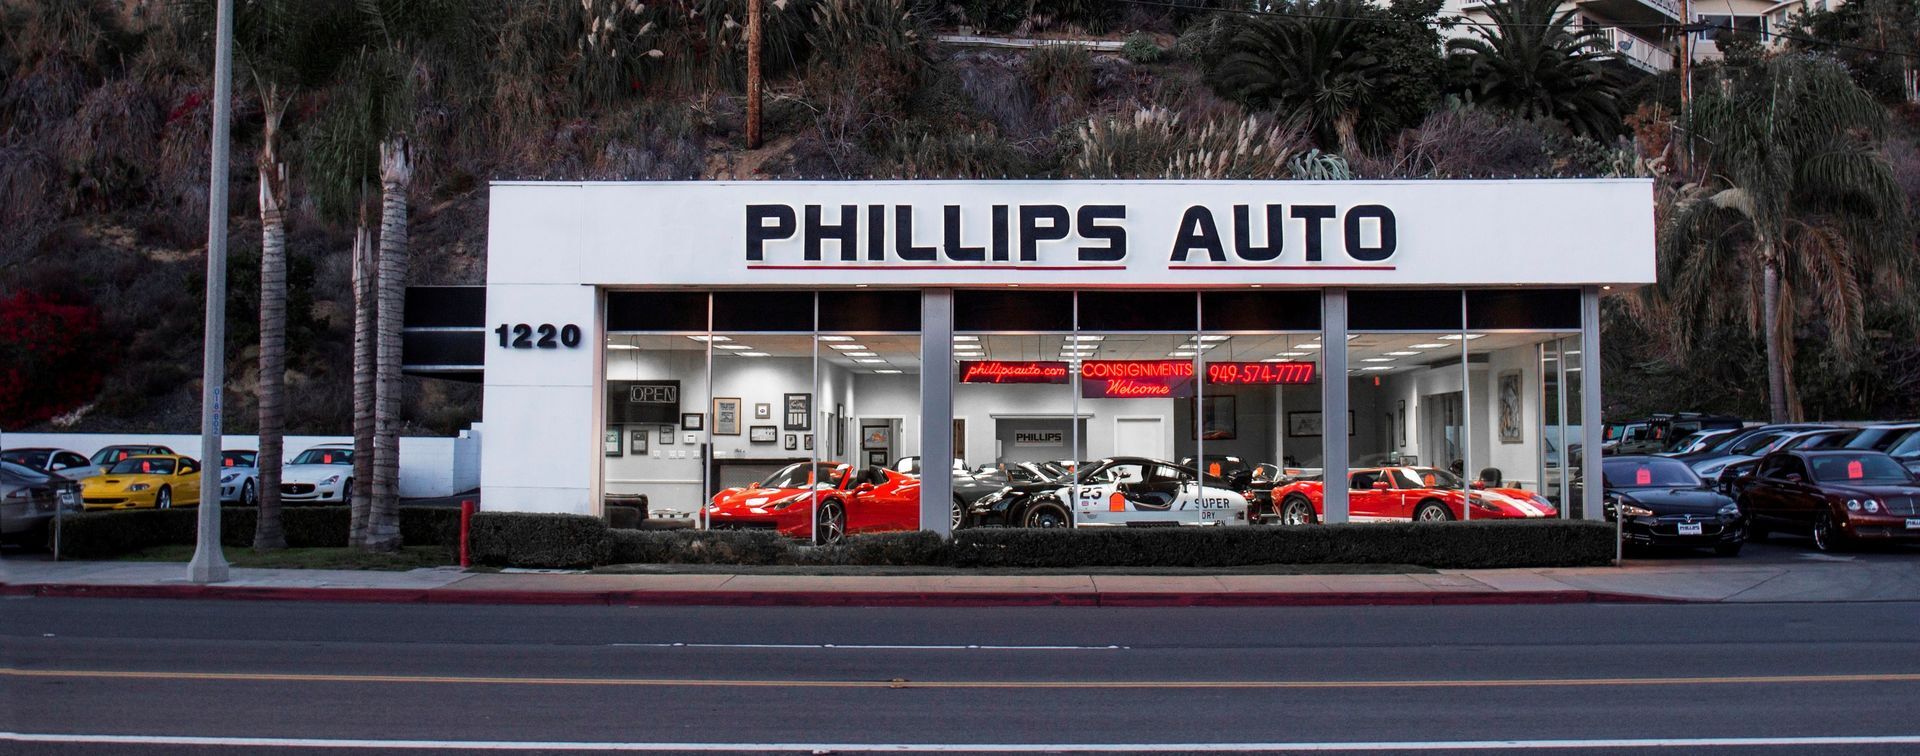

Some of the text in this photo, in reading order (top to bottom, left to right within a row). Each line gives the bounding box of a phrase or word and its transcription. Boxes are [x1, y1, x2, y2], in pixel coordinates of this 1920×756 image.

[746, 204, 1397, 261] PHILLIPS AUTO
[495, 323, 561, 349] 1220
[963, 362, 1066, 383] phillipsauto.com
[1082, 362, 1193, 377] CONSIGNMENTS
[1209, 364, 1313, 383] 949-574-7777
[632, 387, 675, 401] OPEN
[1106, 378, 1170, 395] Welcome
[1015, 432, 1062, 441] PHILLIPS
[1194, 498, 1230, 509] SUPER
